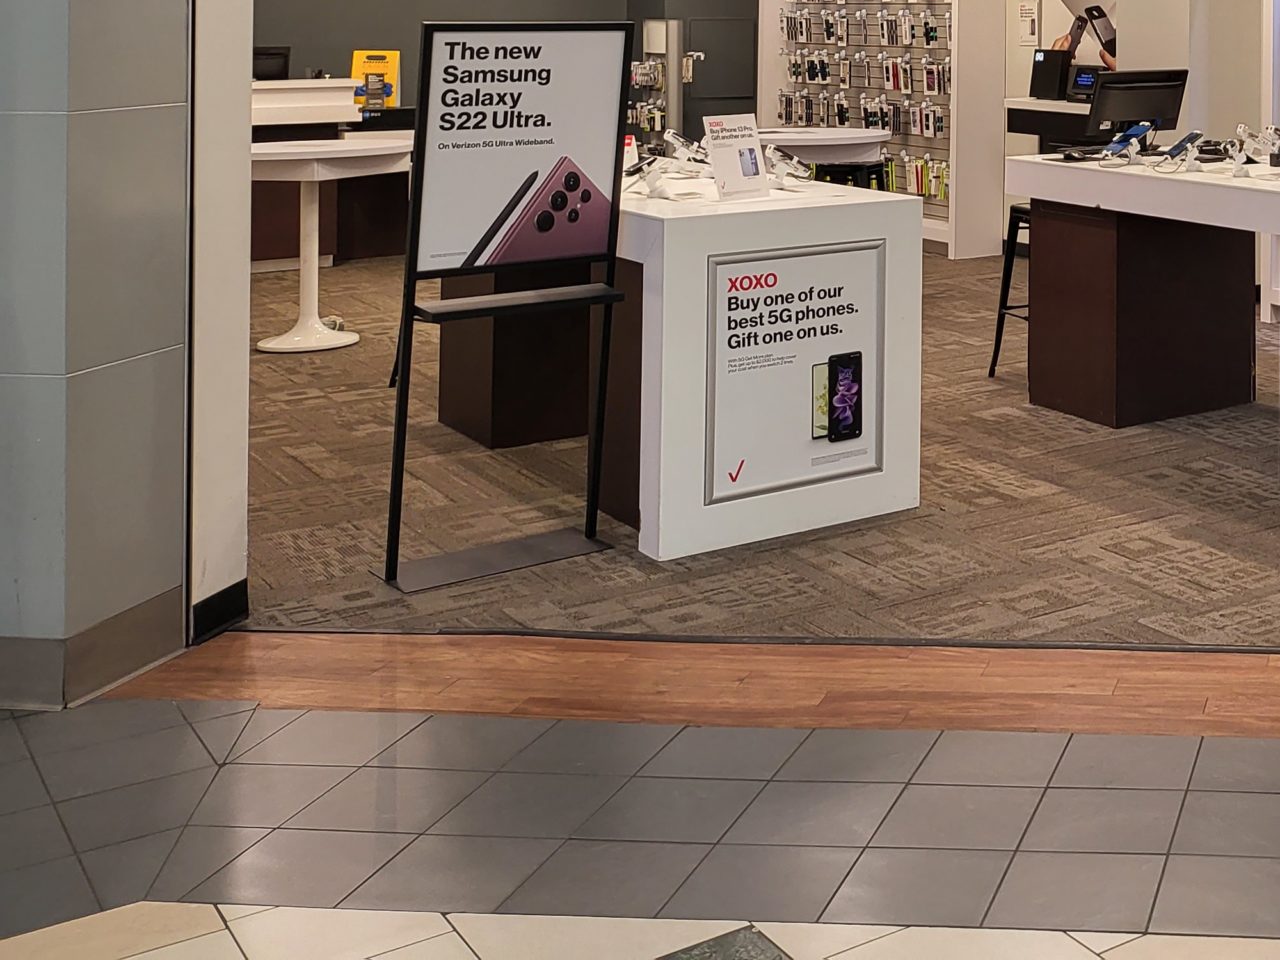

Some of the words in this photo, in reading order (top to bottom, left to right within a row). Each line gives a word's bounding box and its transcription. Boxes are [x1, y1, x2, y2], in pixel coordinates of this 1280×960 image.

[444, 41, 489, 60] The
[494, 45, 542, 60] new
[442, 65, 551, 86] Samsung
[440, 88, 523, 109] Galaxy
[438, 111, 487, 131] S22
[492, 110, 552, 129] Ultra.
[437, 142, 450, 150] On
[451, 140, 481, 149] Verizon
[482, 140, 494, 148] 5G
[495, 139, 514, 148] Ultra
[515, 138, 555, 147] Wideband.
[727, 272, 778, 293] XOXO
[727, 295, 761, 312] Buy
[763, 293, 795, 307] one
[797, 287, 815, 303] of
[817, 286, 844, 300] our
[727, 312, 765, 331] best
[767, 308, 792, 325] 5G
[795, 301, 859, 324] phones.
[727, 331, 760, 349] Gift
[762, 329, 793, 344] one
[796, 326, 817, 340] on
[820, 323, 843, 336] us.
